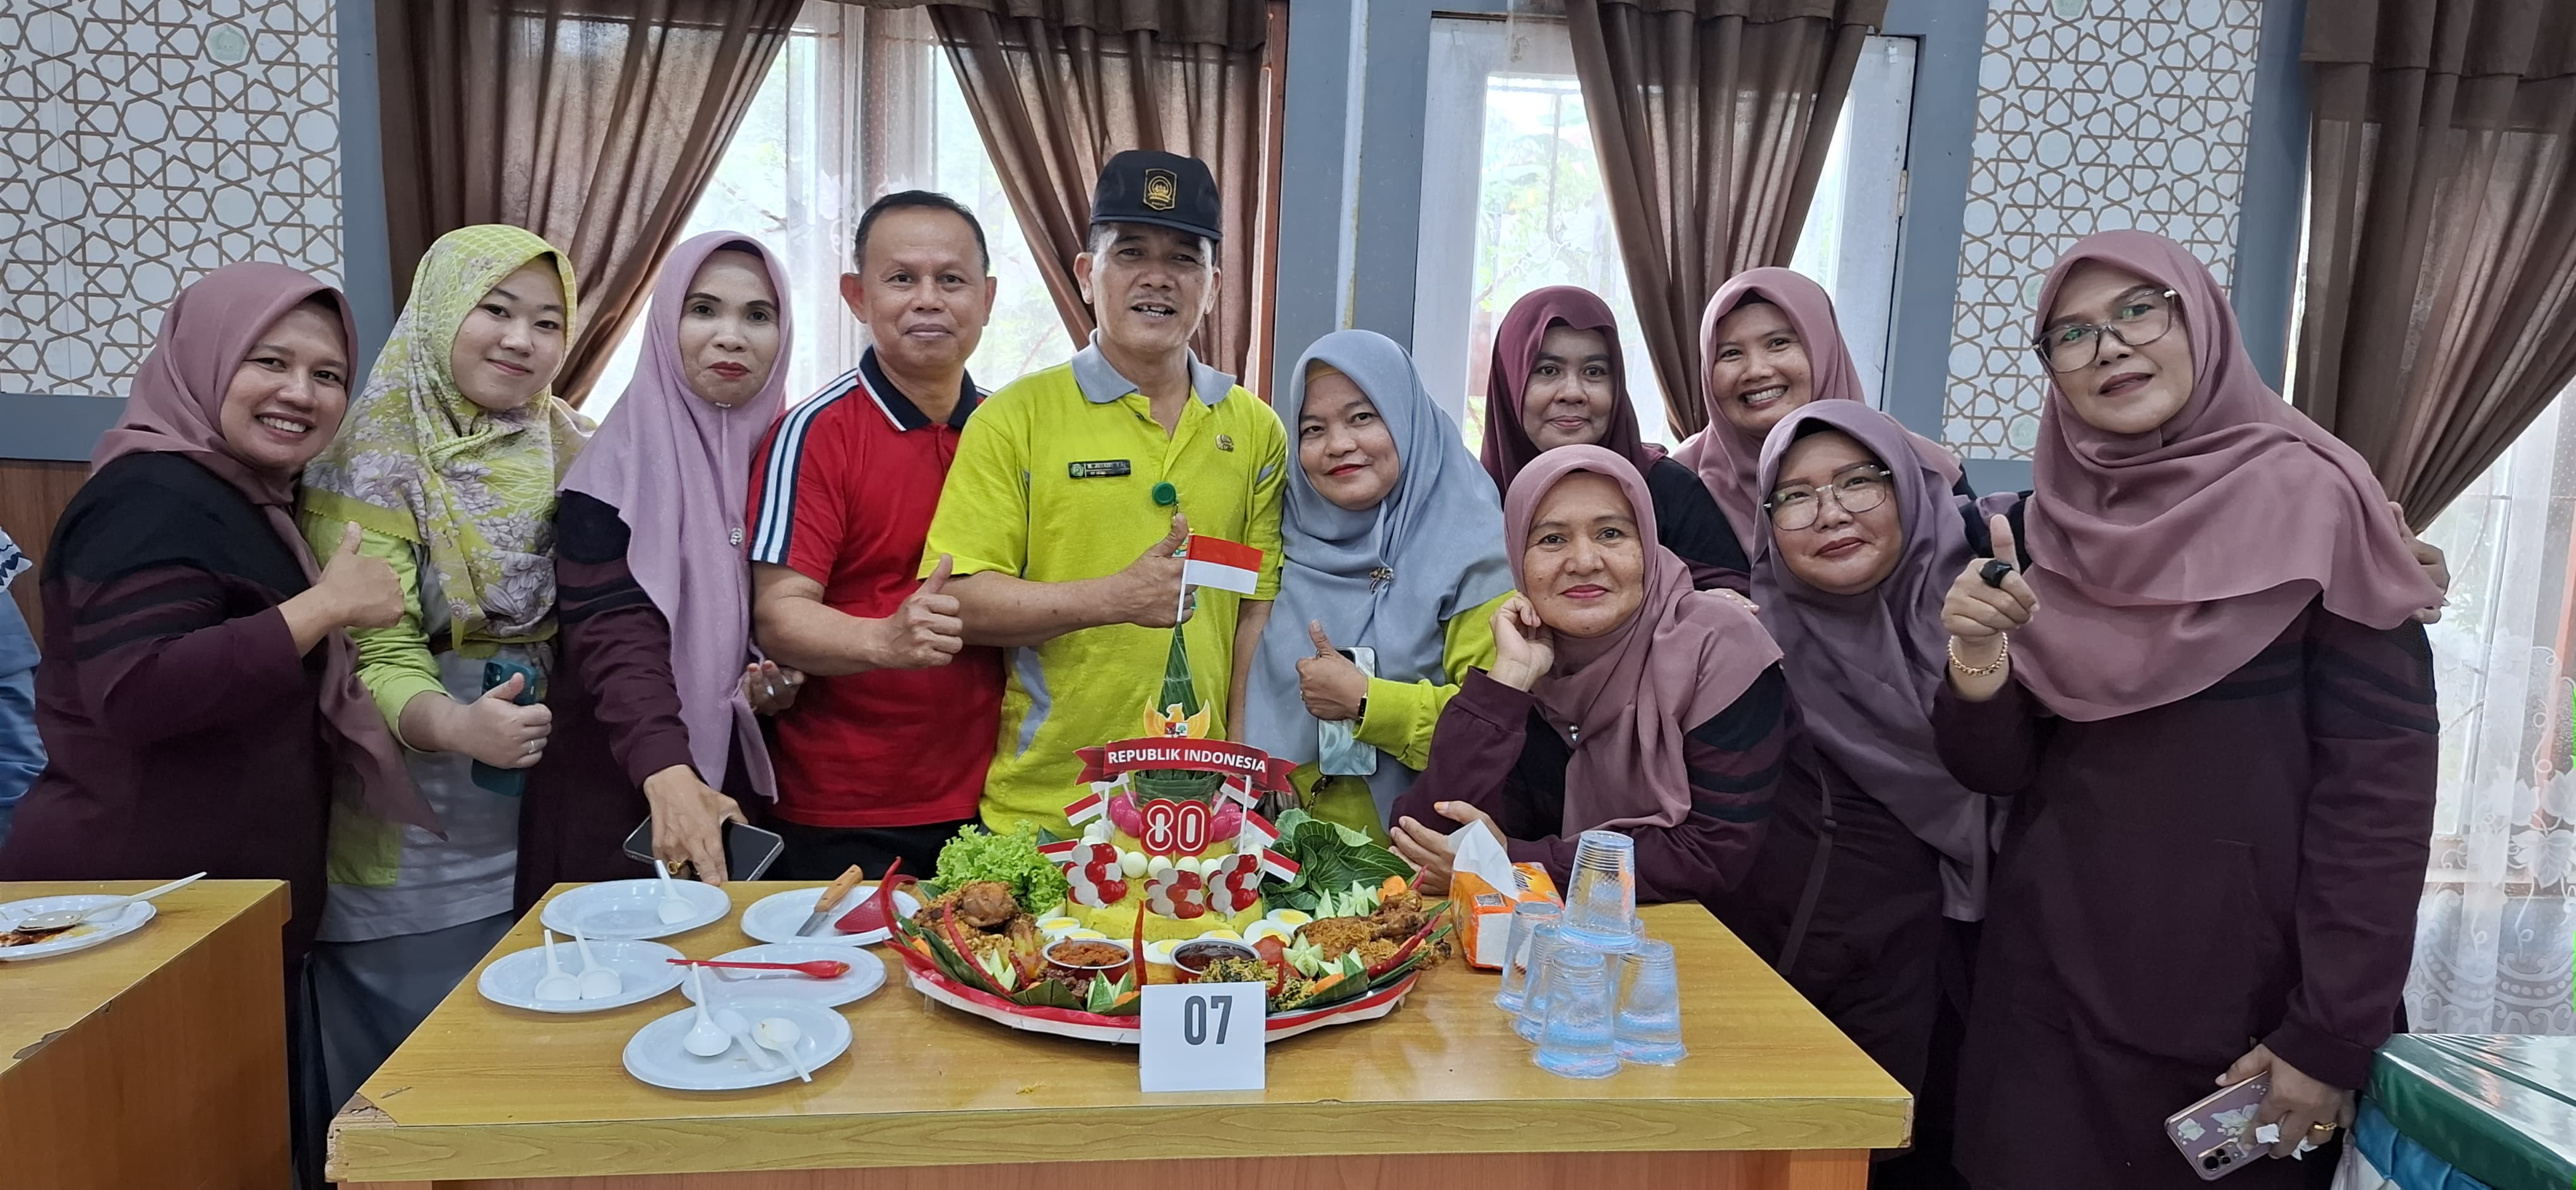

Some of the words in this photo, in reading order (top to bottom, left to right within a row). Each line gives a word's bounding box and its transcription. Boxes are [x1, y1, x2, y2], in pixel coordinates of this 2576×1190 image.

[1108, 748, 1179, 764] REPUBLIK
[1184, 749, 1266, 772] INDONESIA
[1145, 805, 1205, 851] 80
[1184, 995, 1232, 1045] 07
